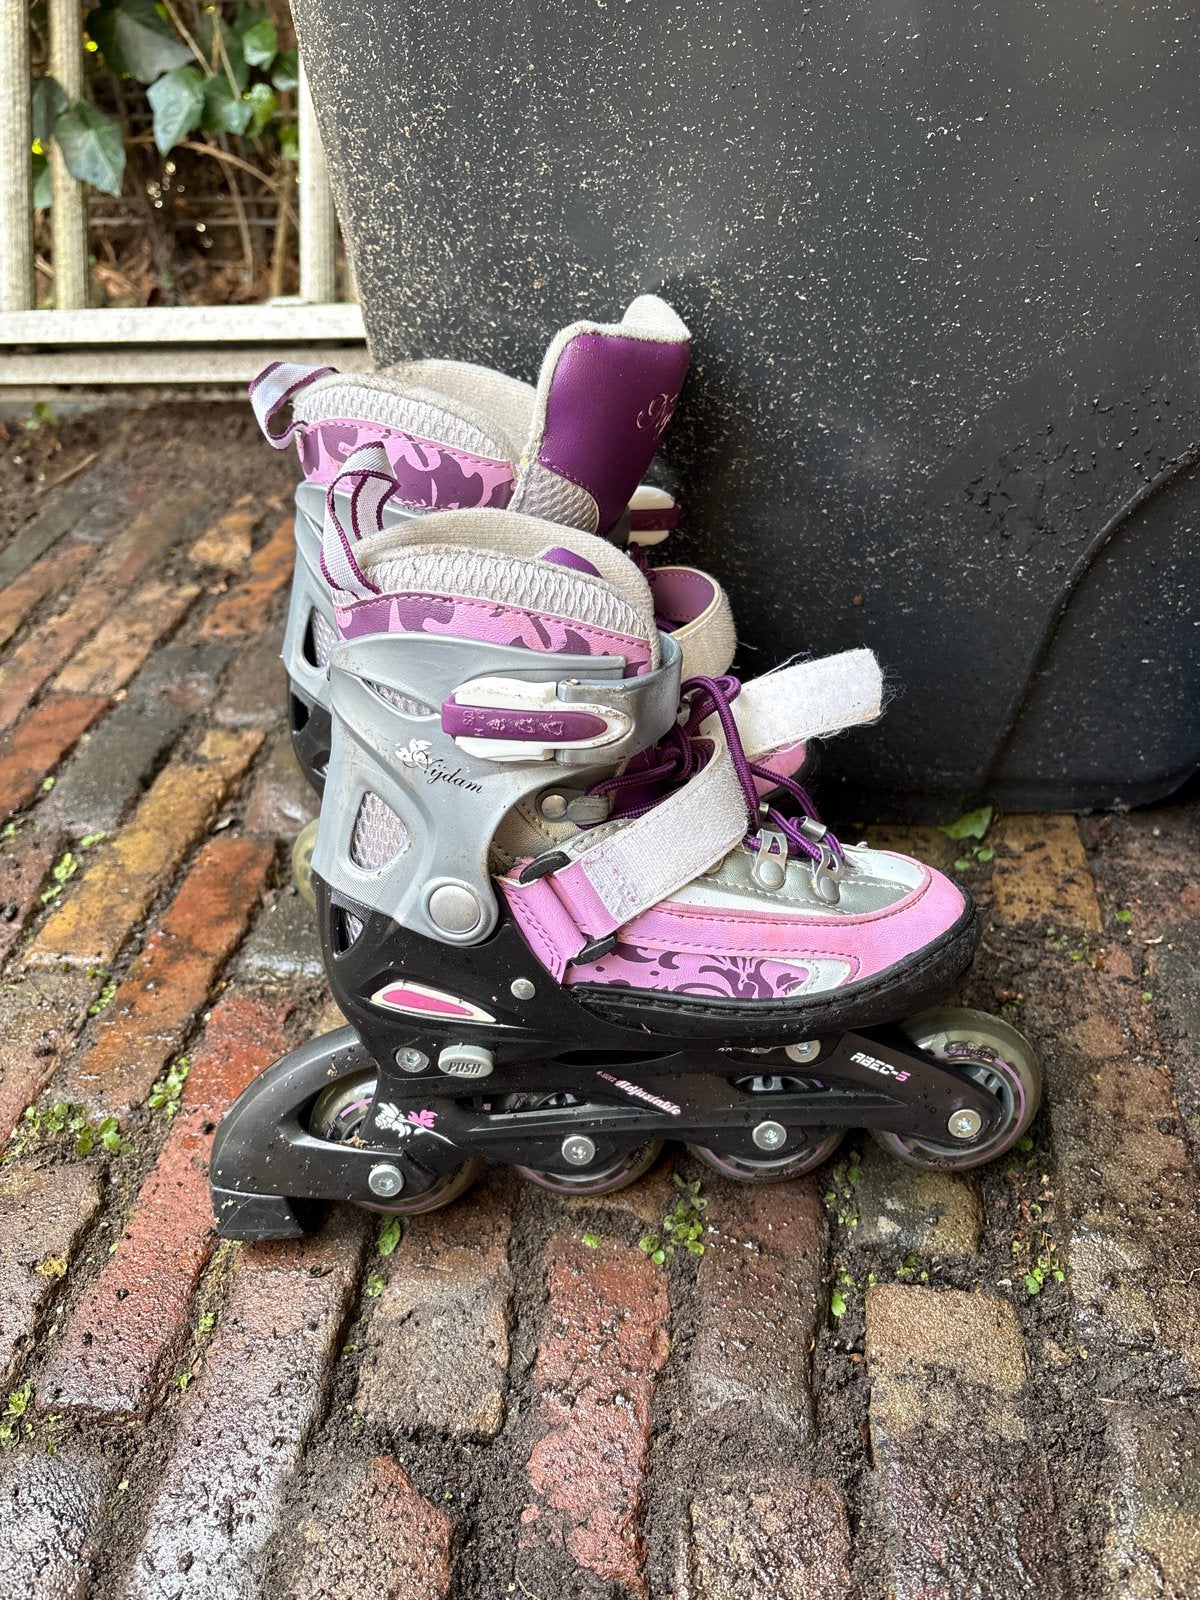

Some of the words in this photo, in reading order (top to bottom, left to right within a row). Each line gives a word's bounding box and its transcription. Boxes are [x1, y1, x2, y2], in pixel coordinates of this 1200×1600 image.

[402, 750, 483, 794] Nijdam
[447, 1061, 482, 1076] PUSH
[849, 1052, 912, 1083] ABEC-5
